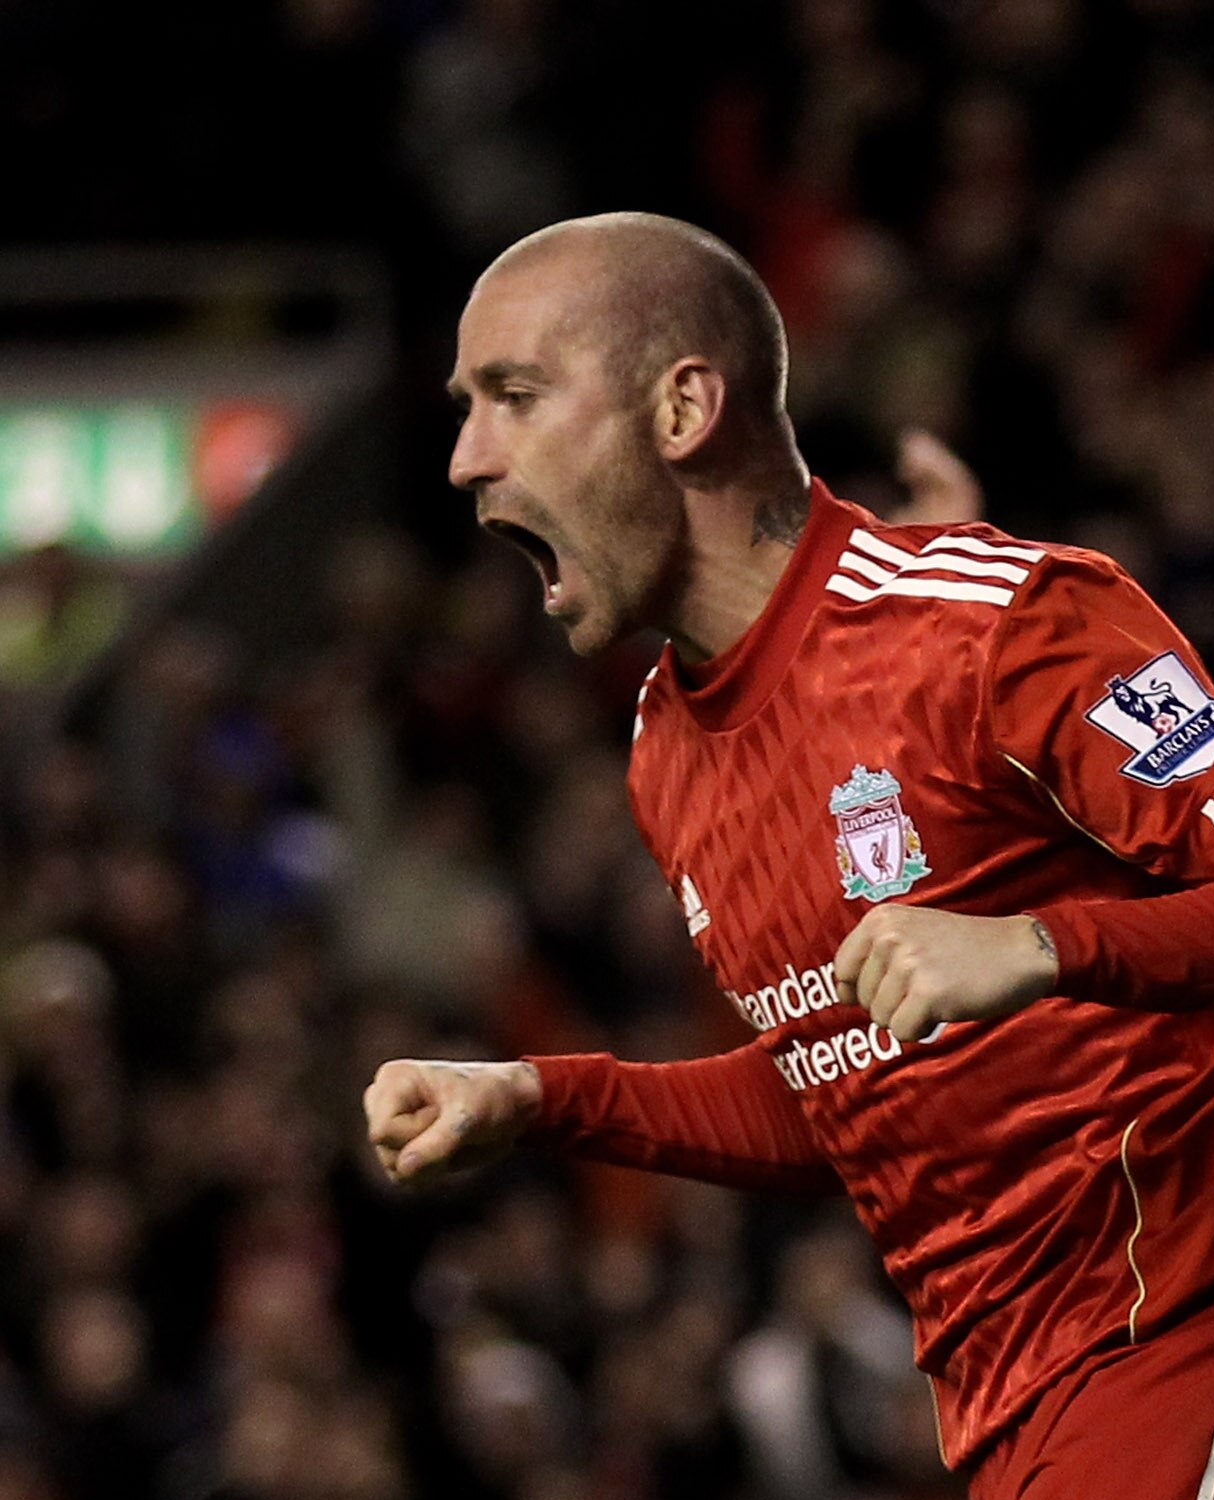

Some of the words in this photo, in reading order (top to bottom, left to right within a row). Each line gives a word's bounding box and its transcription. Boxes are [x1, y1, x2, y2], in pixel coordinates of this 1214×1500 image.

[1146, 714, 1210, 769] BARCLAYS
[844, 805, 898, 832] LIVERPOOL
[724, 961, 840, 1031] tandar
